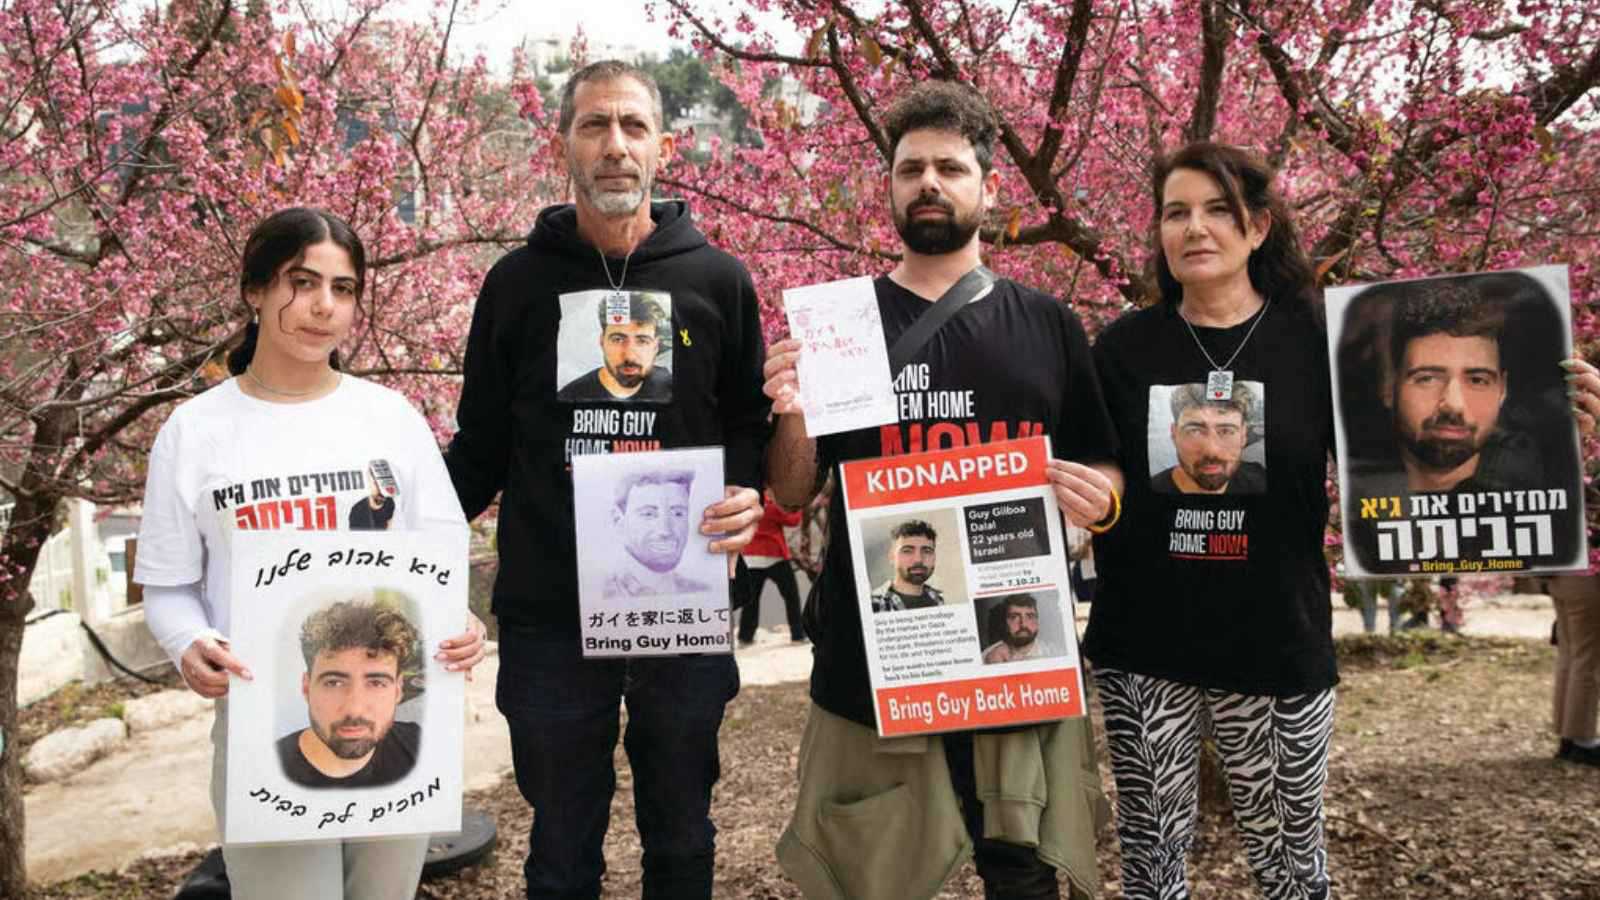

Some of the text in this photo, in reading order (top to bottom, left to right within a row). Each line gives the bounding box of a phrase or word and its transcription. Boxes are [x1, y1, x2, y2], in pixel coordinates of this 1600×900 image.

[928, 390, 975, 418] HOME
[573, 409, 656, 436] BRING GUY
[565, 438, 610, 463] HOME
[289, 470, 365, 495] מחזירים
[866, 451, 1028, 493] KIDNAPPED
[212, 483, 245, 511] גיא
[250, 477, 281, 500] את
[968, 505, 1026, 520] Guy Gilboa
[1360, 488, 1568, 519] מחזירים את גיא
[970, 520, 997, 532] Dalal
[1175, 508, 1245, 530] BRING GUY
[972, 528, 1034, 545] 22 years old
[1169, 532, 1248, 555] HOME NOW!
[1377, 514, 1554, 561] הביתה
[973, 545, 1005, 557] Israeli
[255, 549, 450, 588] גיא אהוב שלנו
[589, 608, 729, 628] ガイを家に返して
[585, 632, 731, 651] Bring Guy Home!
[889, 684, 1070, 724] Bring Guy Back Home
[250, 777, 441, 829] מחכים לך בבית
